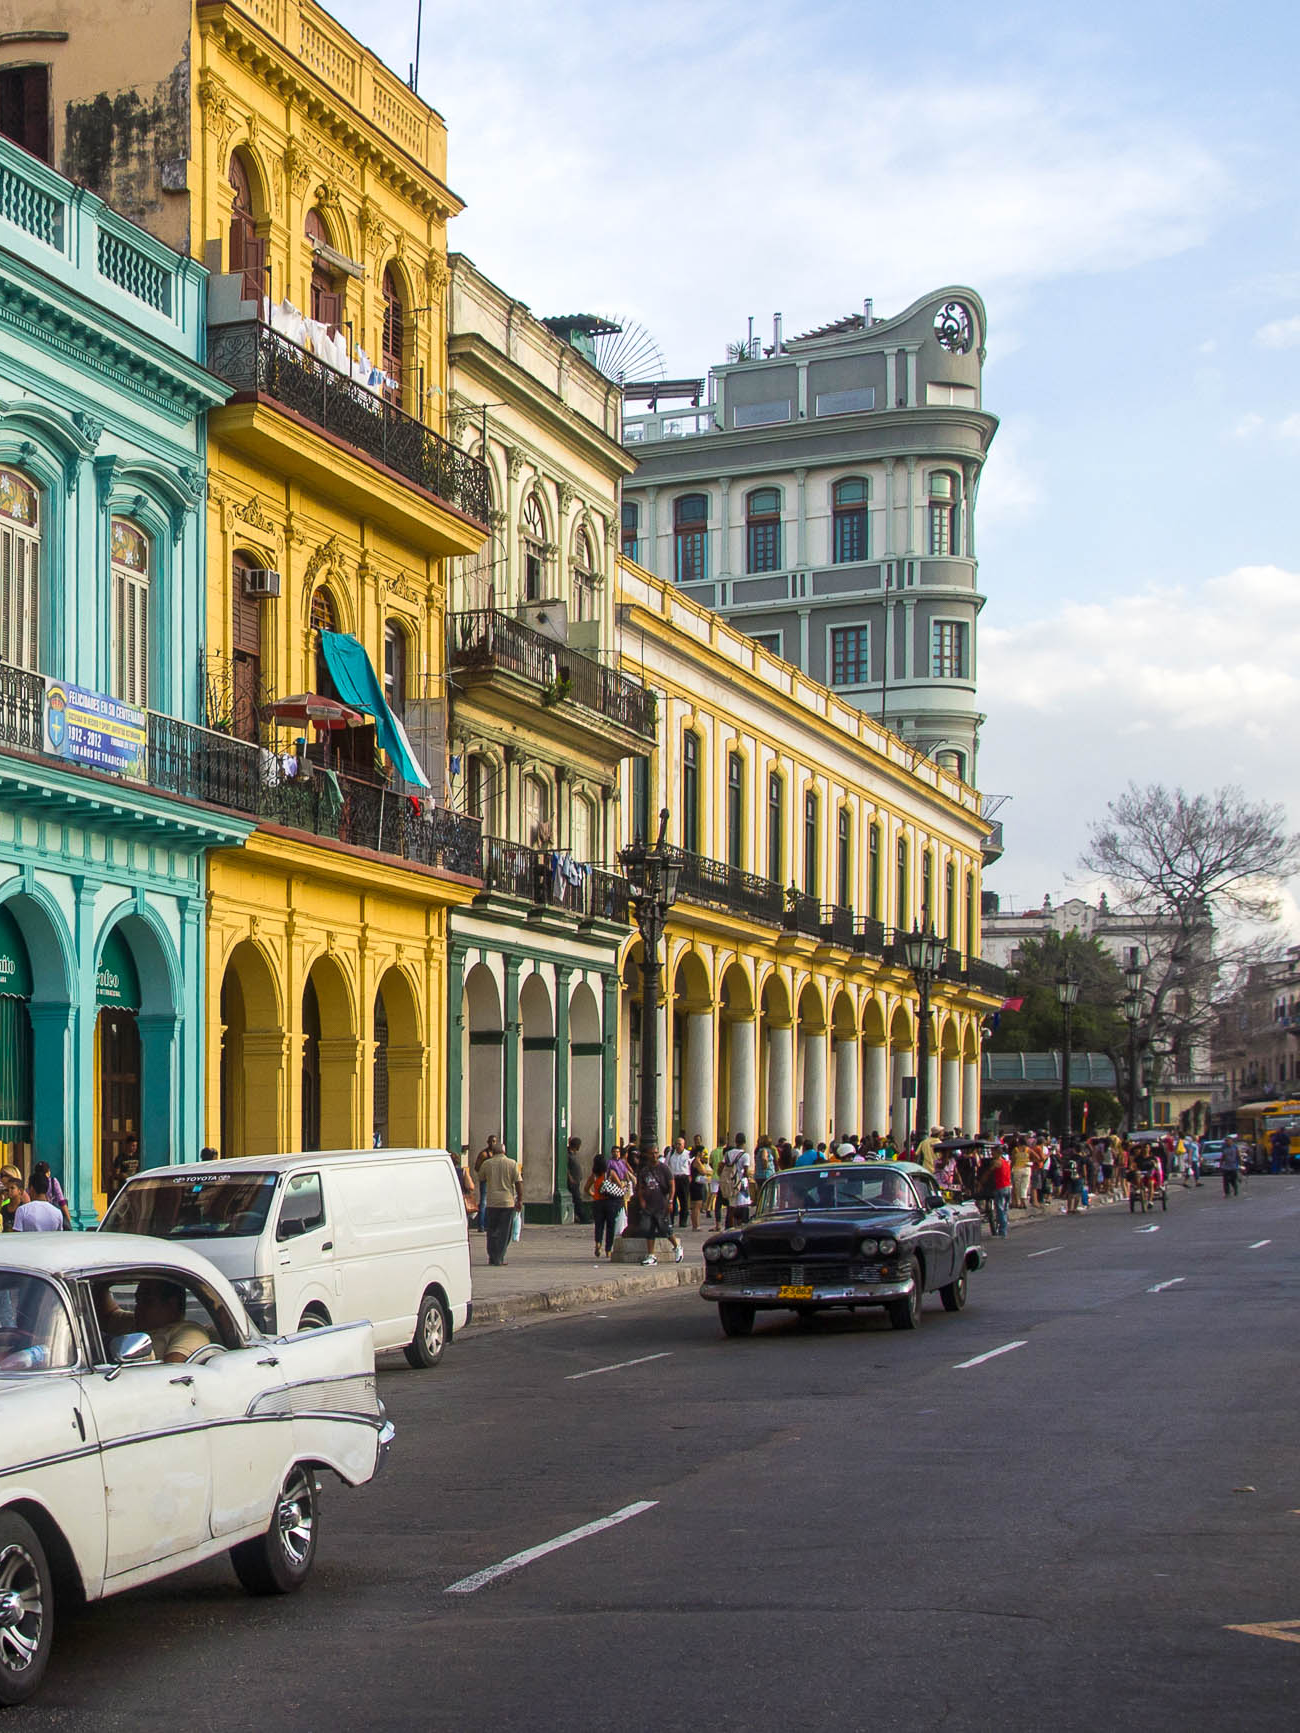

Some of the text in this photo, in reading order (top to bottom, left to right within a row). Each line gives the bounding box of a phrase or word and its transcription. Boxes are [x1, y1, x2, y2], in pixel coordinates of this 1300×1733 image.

[69, 690, 100, 712] FELICIDADES
[101, 700, 108, 715] EN
[68, 725, 82, 743] 1912
[87, 731, 102, 748] 2012
[70, 744, 79, 755] 100
[80, 745, 94, 759] AÑOS
[94, 750, 101, 761] DE
